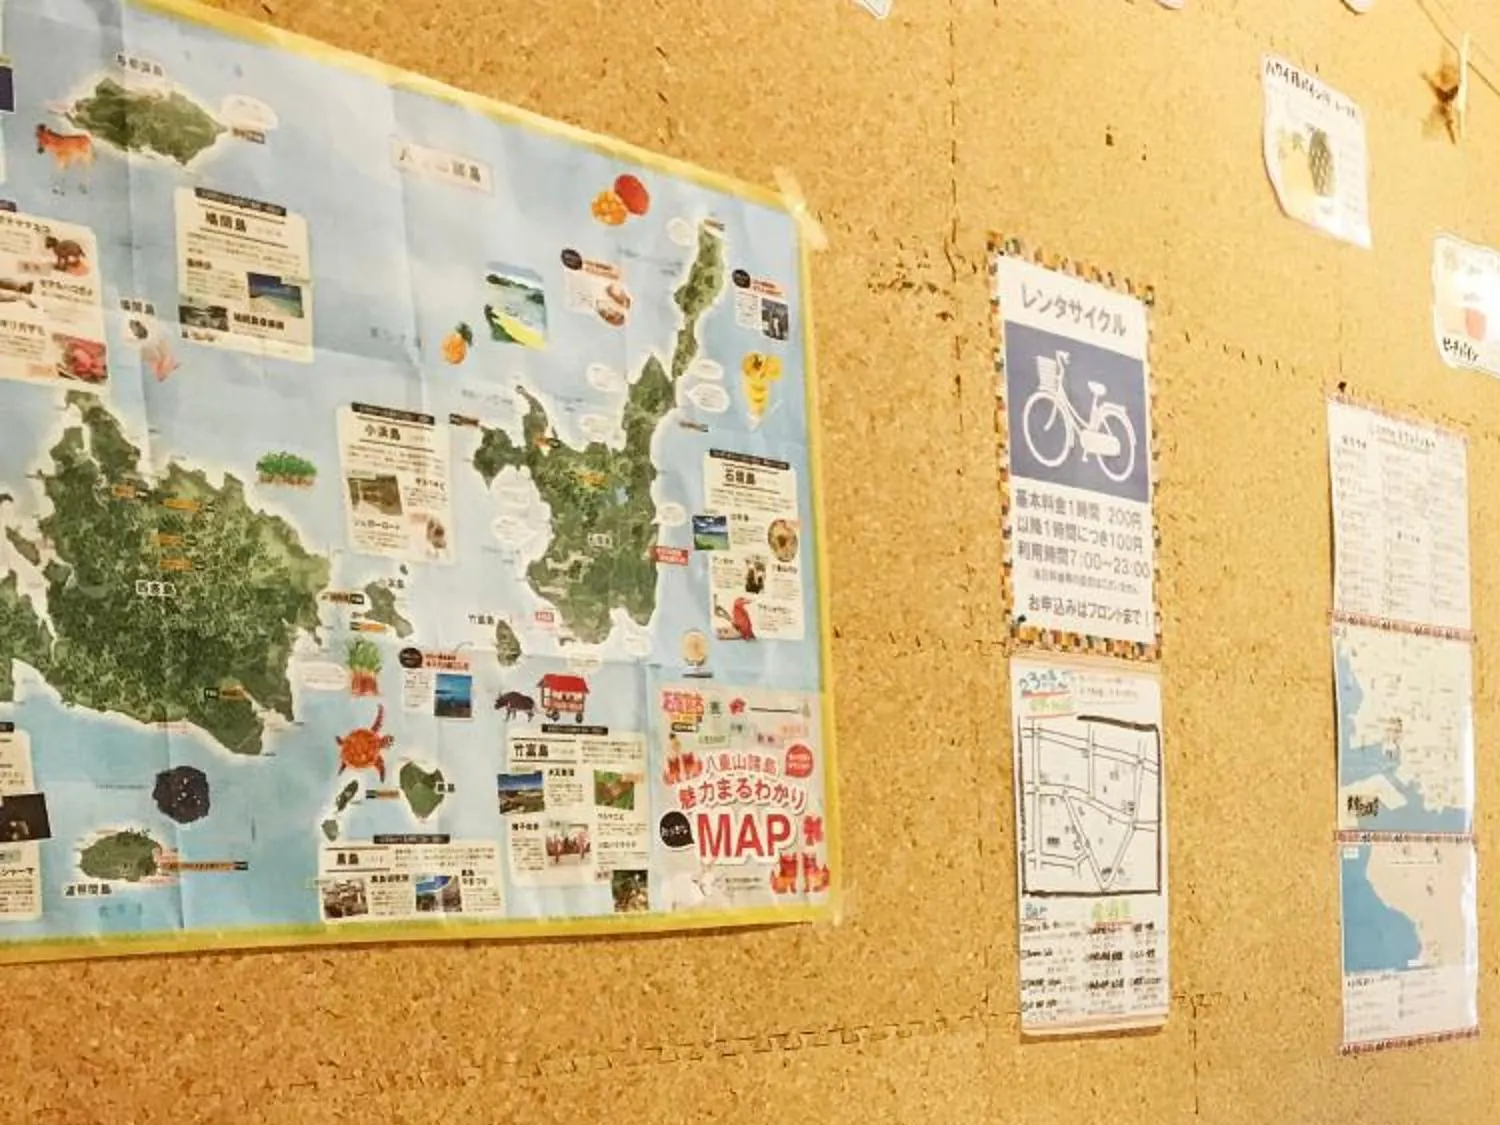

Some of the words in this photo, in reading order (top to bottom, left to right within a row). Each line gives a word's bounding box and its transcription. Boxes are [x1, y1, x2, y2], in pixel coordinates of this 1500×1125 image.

[1021, 282, 1127, 336] レンタサイクル
[1016, 489, 1100, 521] 基本料金1時間
[1108, 506, 1142, 531] 200円
[1017, 516, 1143, 555] 以降1時間につき100円
[678, 776, 804, 810] 魅力まるわかり
[696, 813, 791, 858] MAP
